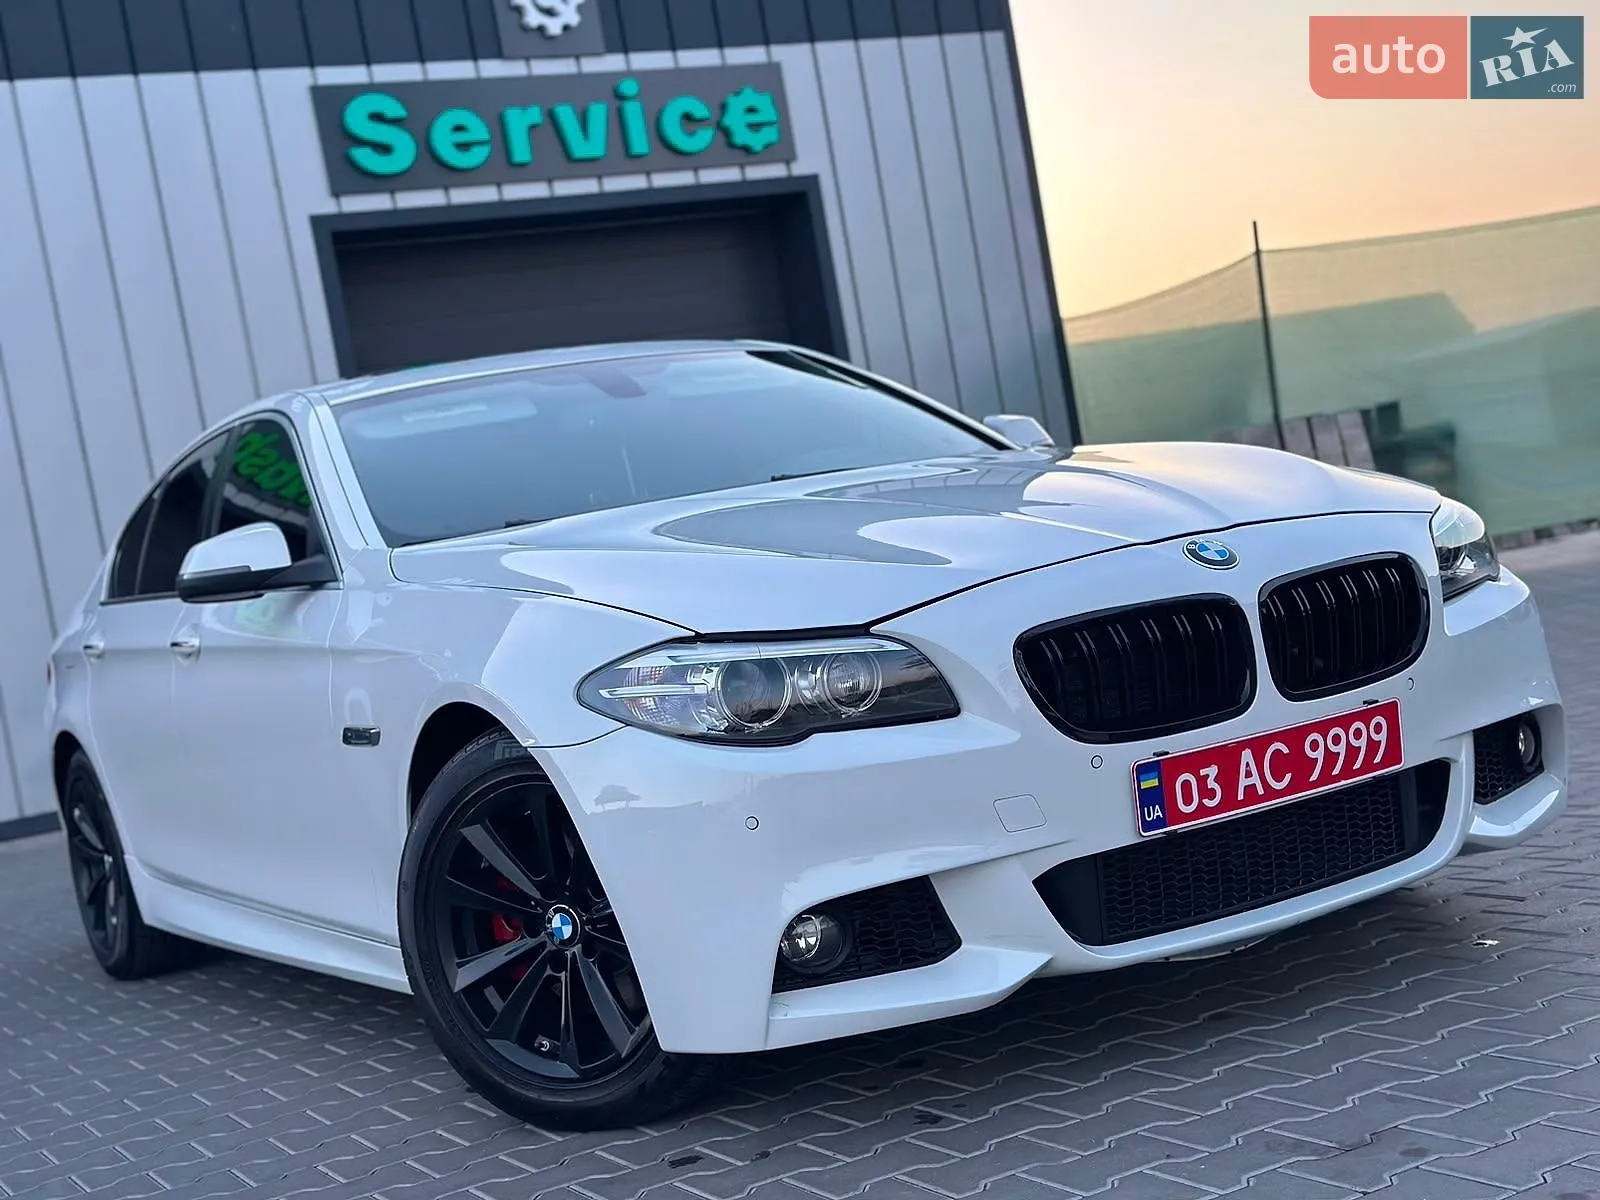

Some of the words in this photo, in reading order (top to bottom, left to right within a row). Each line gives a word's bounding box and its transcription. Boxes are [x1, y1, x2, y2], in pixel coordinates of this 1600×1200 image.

[342, 78, 781, 175] Service
[1144, 804, 1163, 821] UA
[1175, 764, 1222, 813] 03
[1237, 742, 1292, 800] AC
[1304, 715, 1388, 782] 9999
